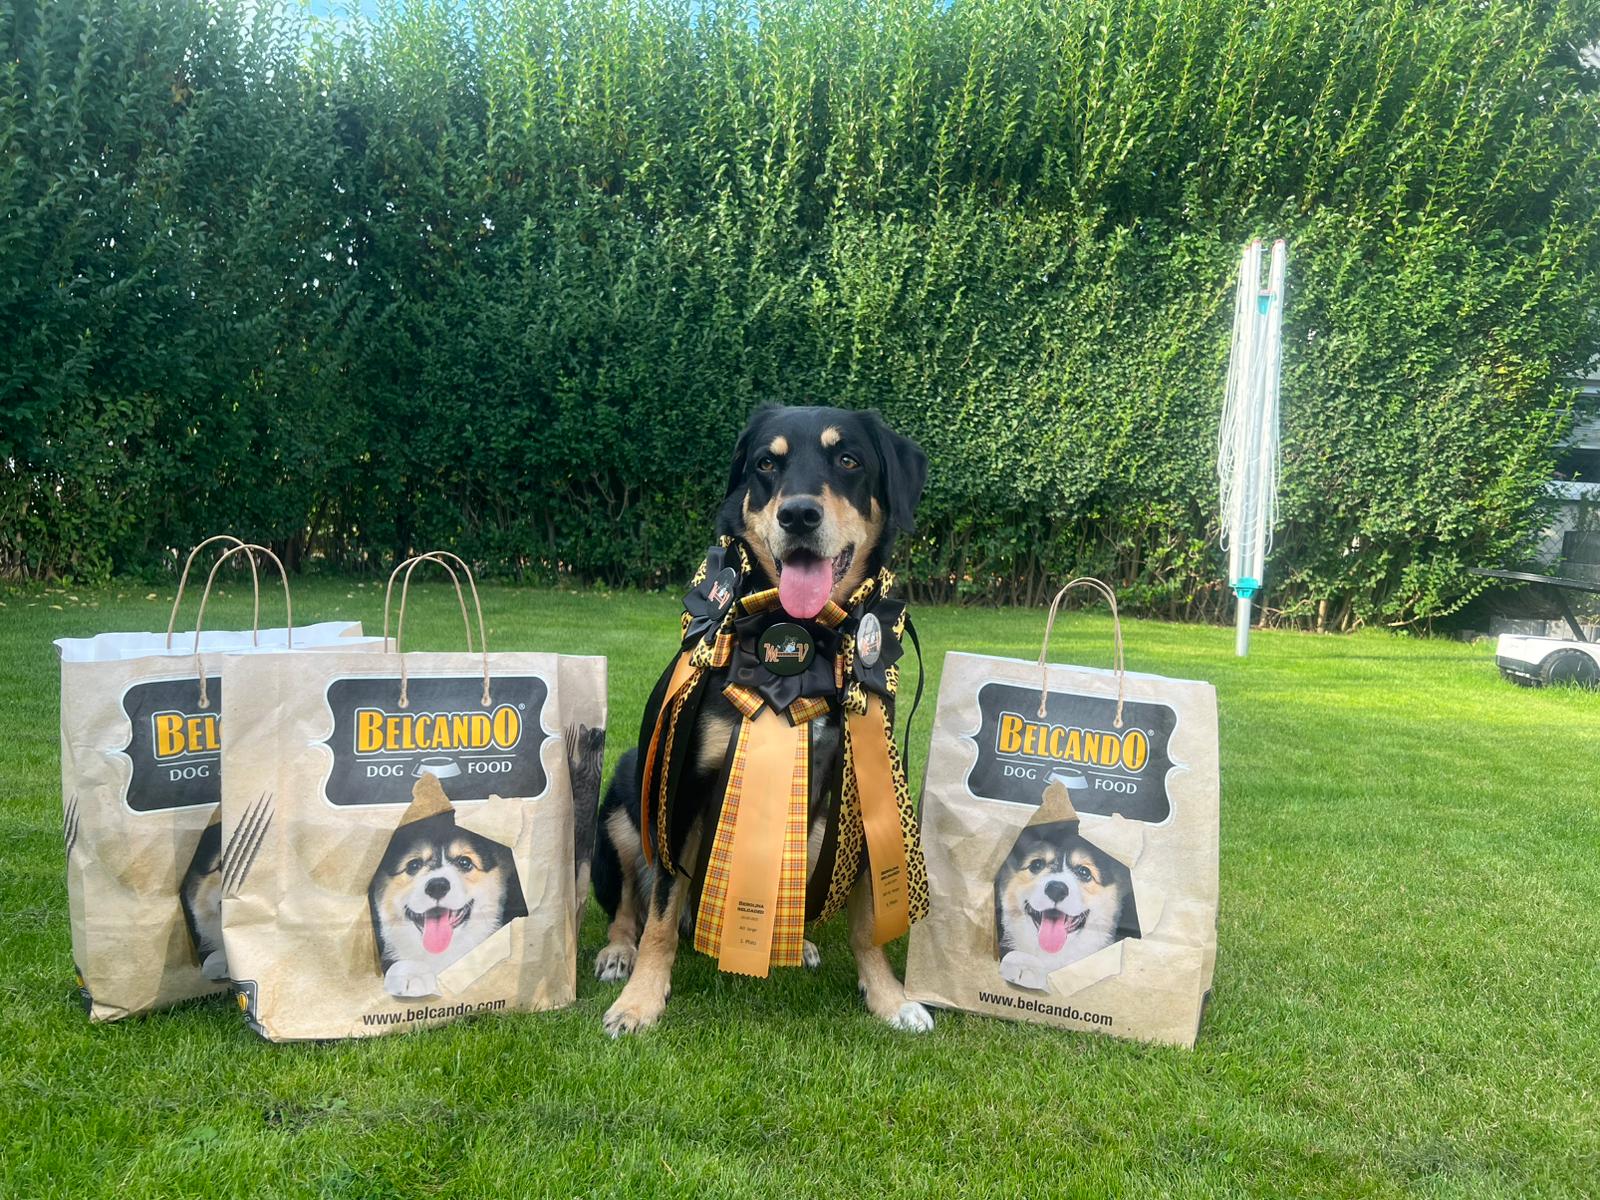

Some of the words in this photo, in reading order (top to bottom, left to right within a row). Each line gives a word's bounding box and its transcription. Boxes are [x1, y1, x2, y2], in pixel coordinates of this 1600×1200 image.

[355, 705, 521, 754] BELCANDO
[997, 712, 1148, 772] BELCANDO
[169, 765, 210, 781] DOG
[366, 765, 404, 778] DOG
[467, 761, 513, 774] FOOD
[1003, 765, 1037, 780] DOG
[1094, 778, 1138, 795] FOOD
[363, 999, 506, 1026] www.belcandocom
[979, 991, 1113, 1026] www.belcando.com
